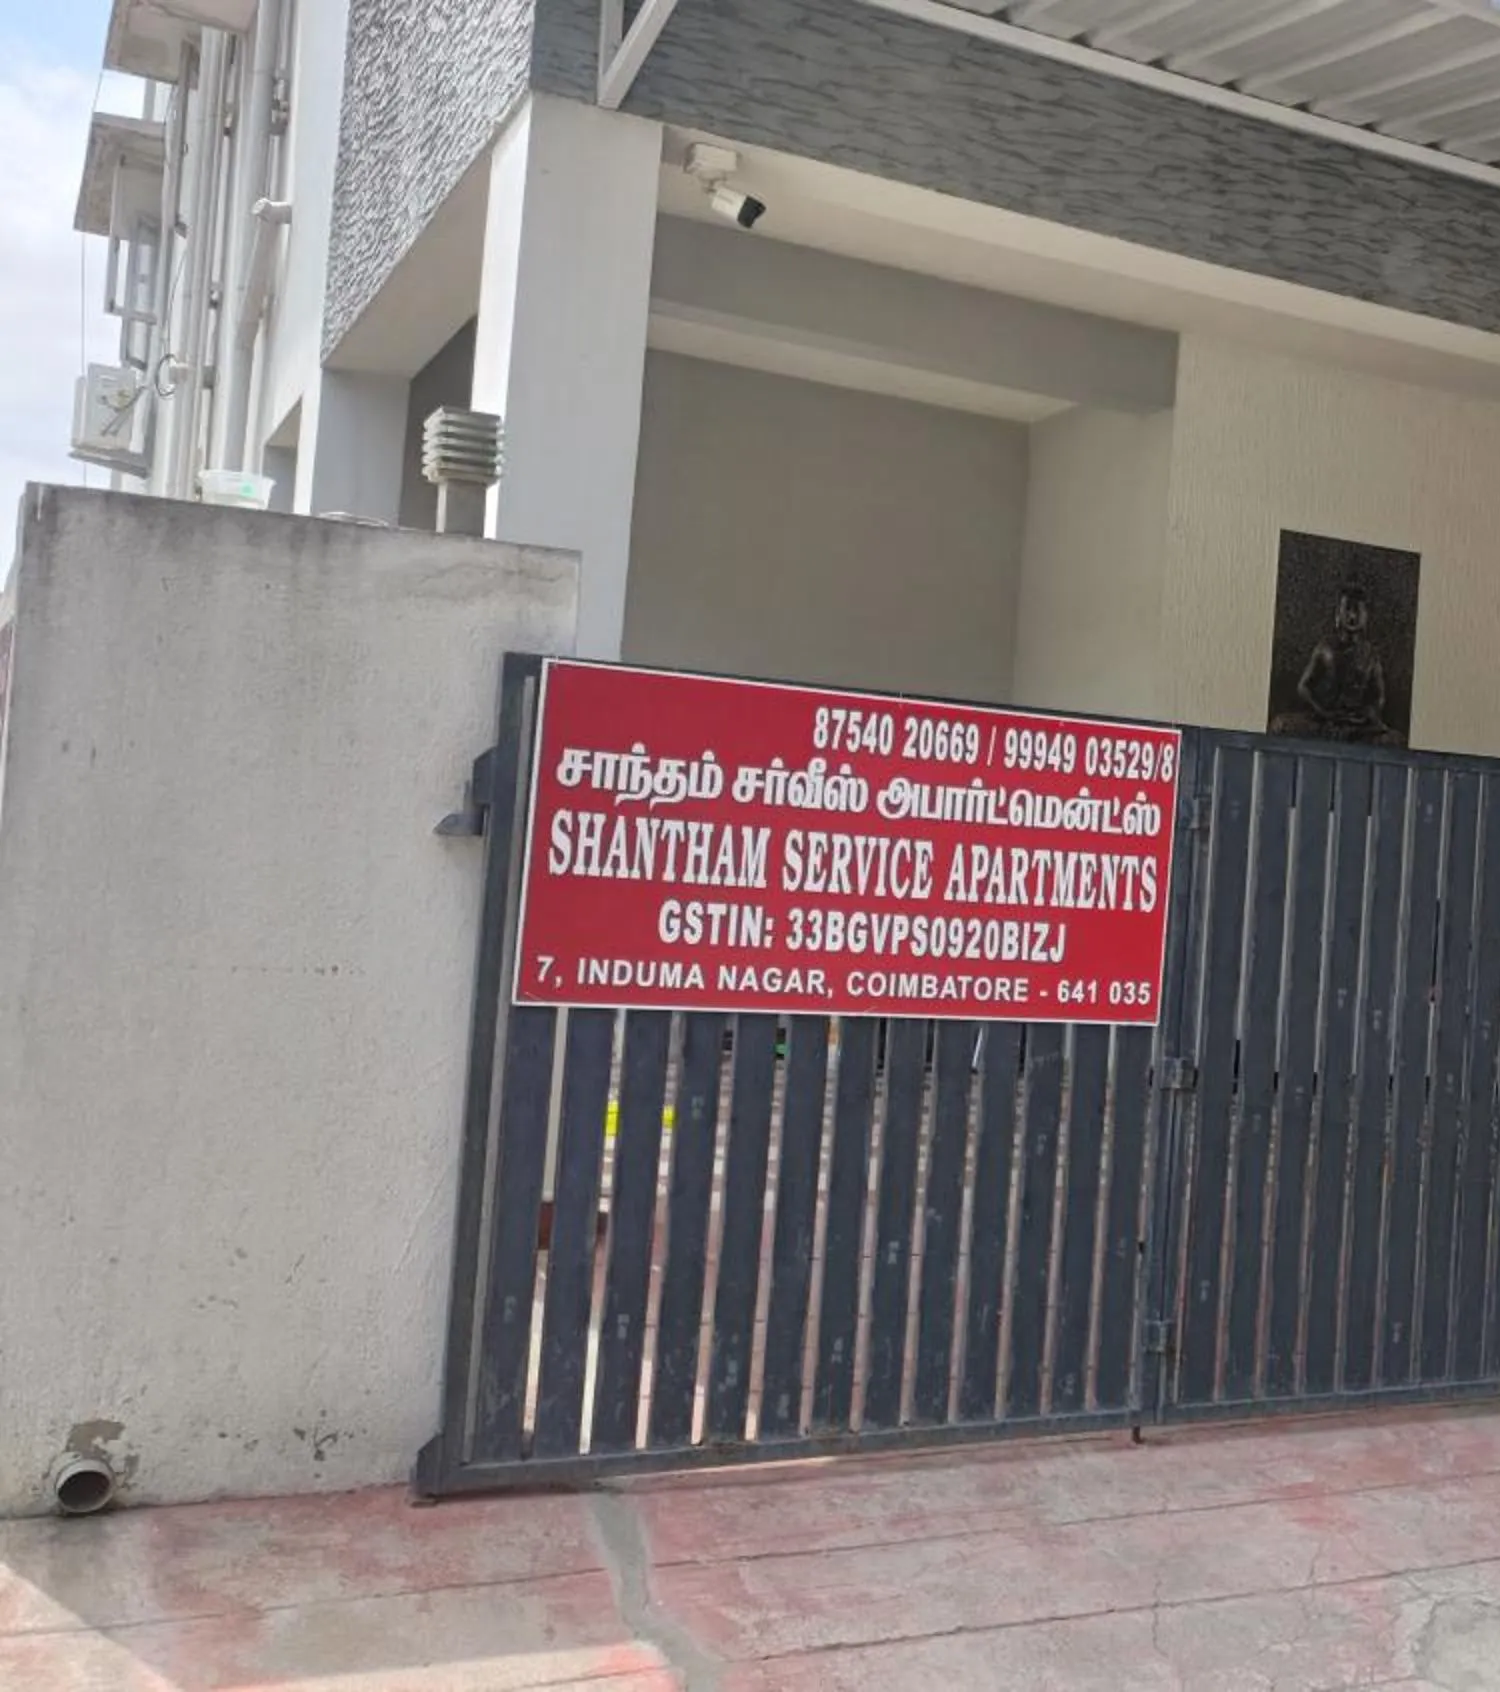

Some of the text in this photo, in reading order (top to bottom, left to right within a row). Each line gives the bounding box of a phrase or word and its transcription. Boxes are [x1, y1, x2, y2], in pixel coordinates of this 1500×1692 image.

[813, 706, 1173, 783] 87540 20669 / 99949 03529/8
[556, 742, 1161, 837] சாந்தம் சர்வீஸ் அபார்ட்மென்ட்ஸ்
[548, 808, 1157, 913] SHANTHAM SERVICE APARTMENTS
[658, 898, 775, 949] GSTIN:
[537, 955, 563, 988] 7,
[577, 957, 705, 990] INDUMA
[717, 964, 833, 999] NAGAR,
[846, 970, 1029, 1003] COIMBATORE
[1057, 979, 1097, 1004] 641
[1109, 980, 1151, 1006] 035
